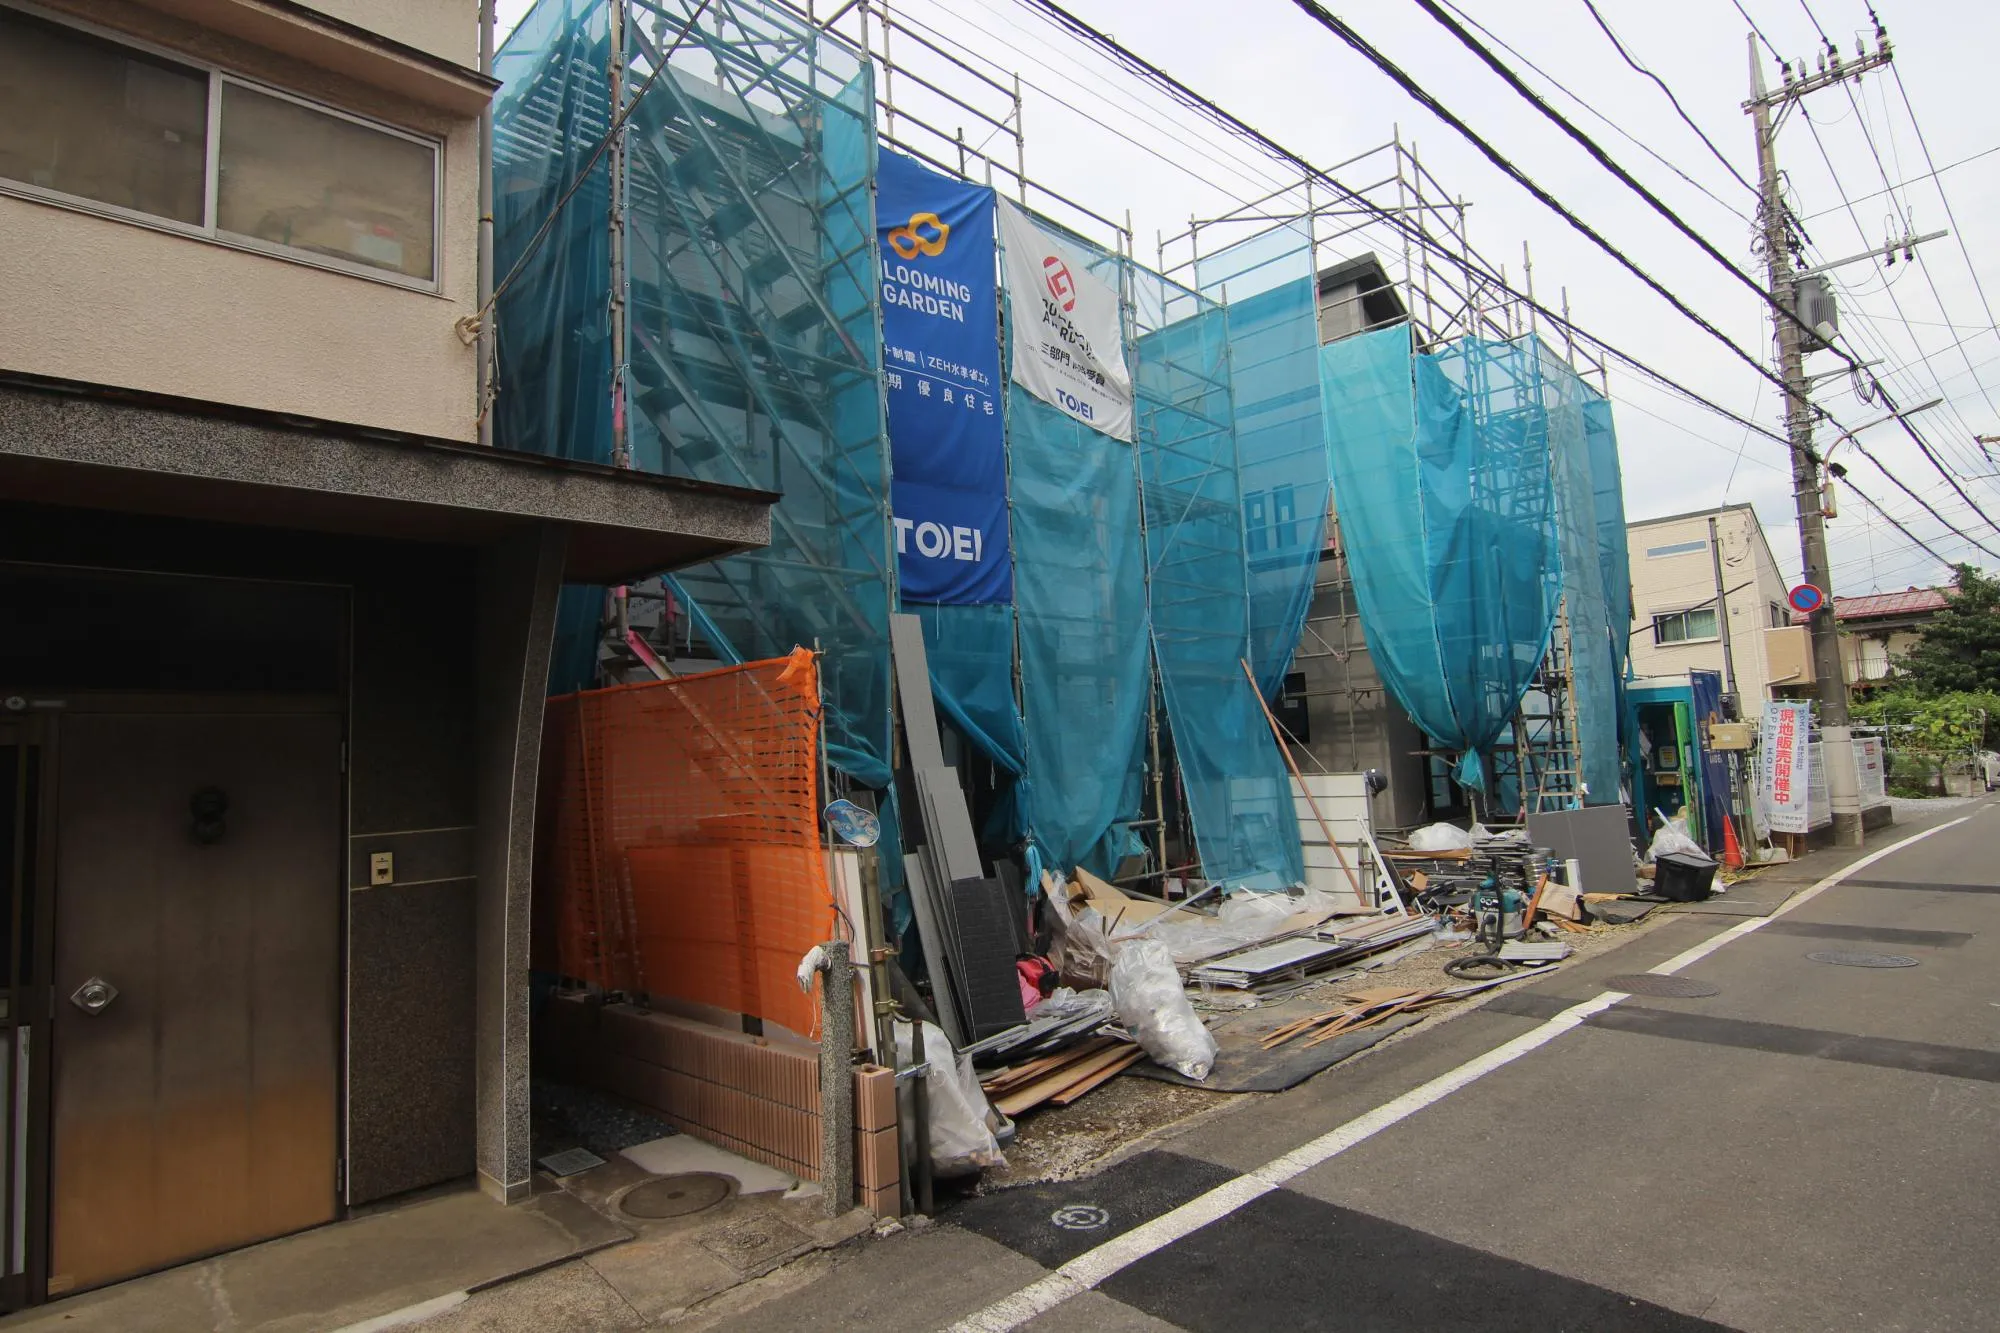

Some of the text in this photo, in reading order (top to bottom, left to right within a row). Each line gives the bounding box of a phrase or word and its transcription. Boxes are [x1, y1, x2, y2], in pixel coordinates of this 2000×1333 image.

[883, 260, 971, 303] LOOMING
[883, 284, 964, 322] GARDEN
[1056, 387, 1094, 421] TOEI
[892, 517, 983, 562] TOEI
[1765, 707, 1778, 790] OPEN HOUSE
[1774, 708, 1795, 806] 現地販売開催中
